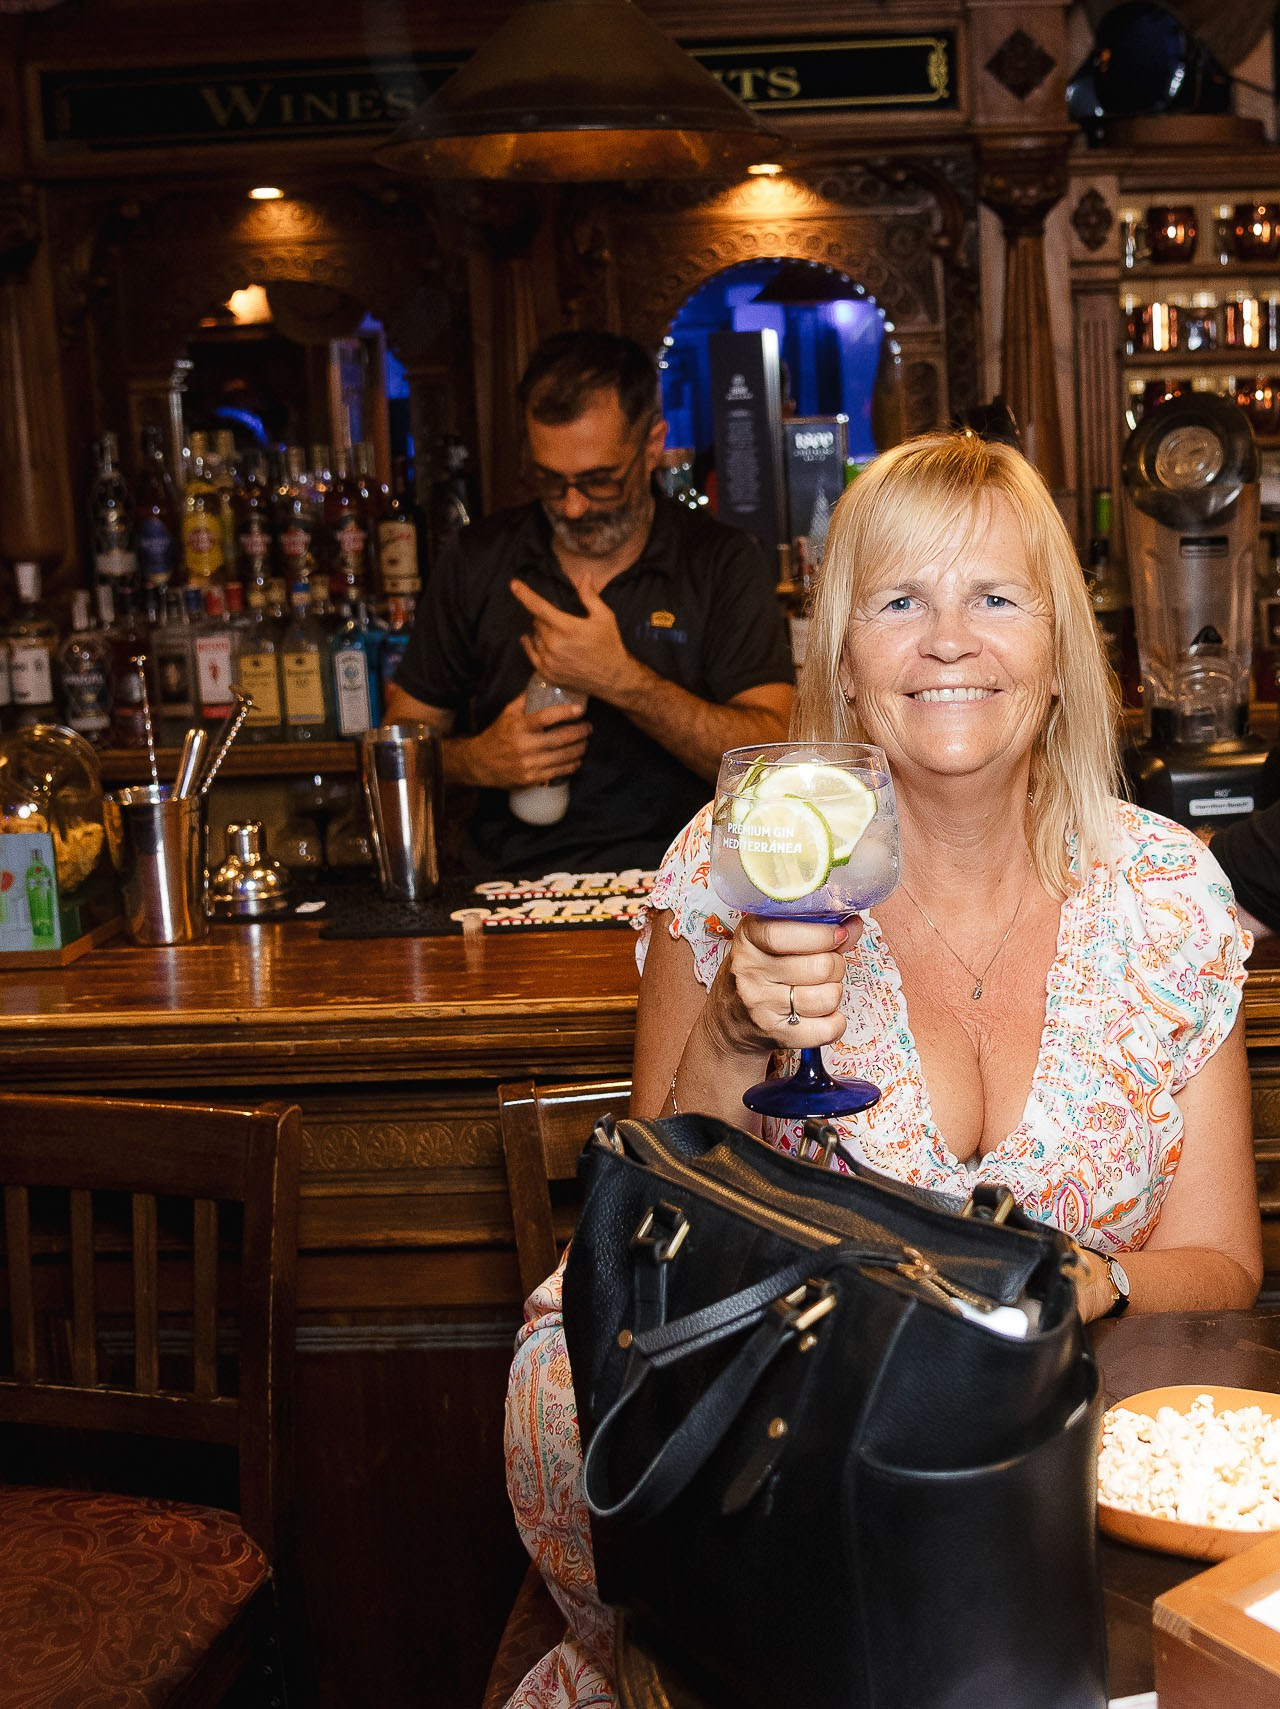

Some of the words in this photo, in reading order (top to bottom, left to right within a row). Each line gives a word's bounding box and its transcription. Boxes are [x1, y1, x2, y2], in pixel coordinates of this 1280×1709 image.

[197, 82, 416, 129] WINES
[727, 822, 770, 837] PREMIUM
[773, 825, 795, 838] GIN
[722, 836, 803, 854] MEDITERRÁNEA
